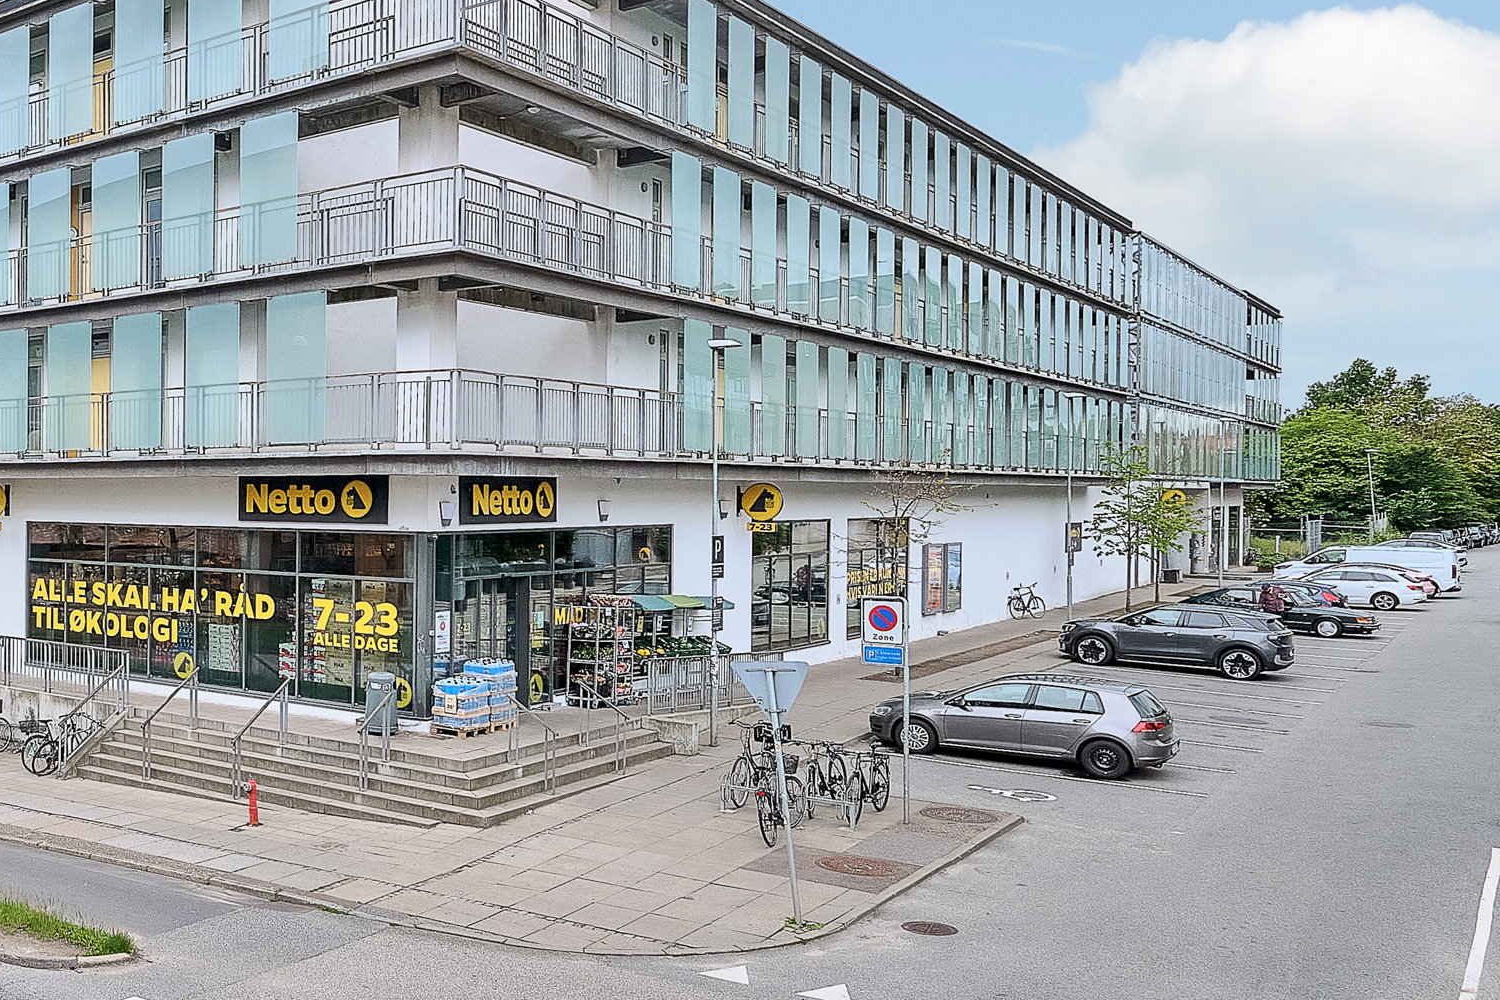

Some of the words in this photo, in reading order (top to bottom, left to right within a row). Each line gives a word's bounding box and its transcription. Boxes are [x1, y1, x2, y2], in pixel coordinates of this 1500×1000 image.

[245, 484, 336, 514] Netto
[472, 484, 531, 515] Netto
[749, 523, 773, 531] 7-23
[715, 539, 722, 560] P
[32, 578, 87, 603] ALLE
[92, 582, 156, 610] SKAL
[215, 583, 276, 620] RÅD
[32, 606, 64, 630] TIL
[69, 610, 178, 643] ØKOLOGI
[313, 598, 399, 636] 7-23
[313, 633, 350, 648] ALLE
[355, 637, 398, 653] DAGE
[872, 633, 894, 641] Zone
